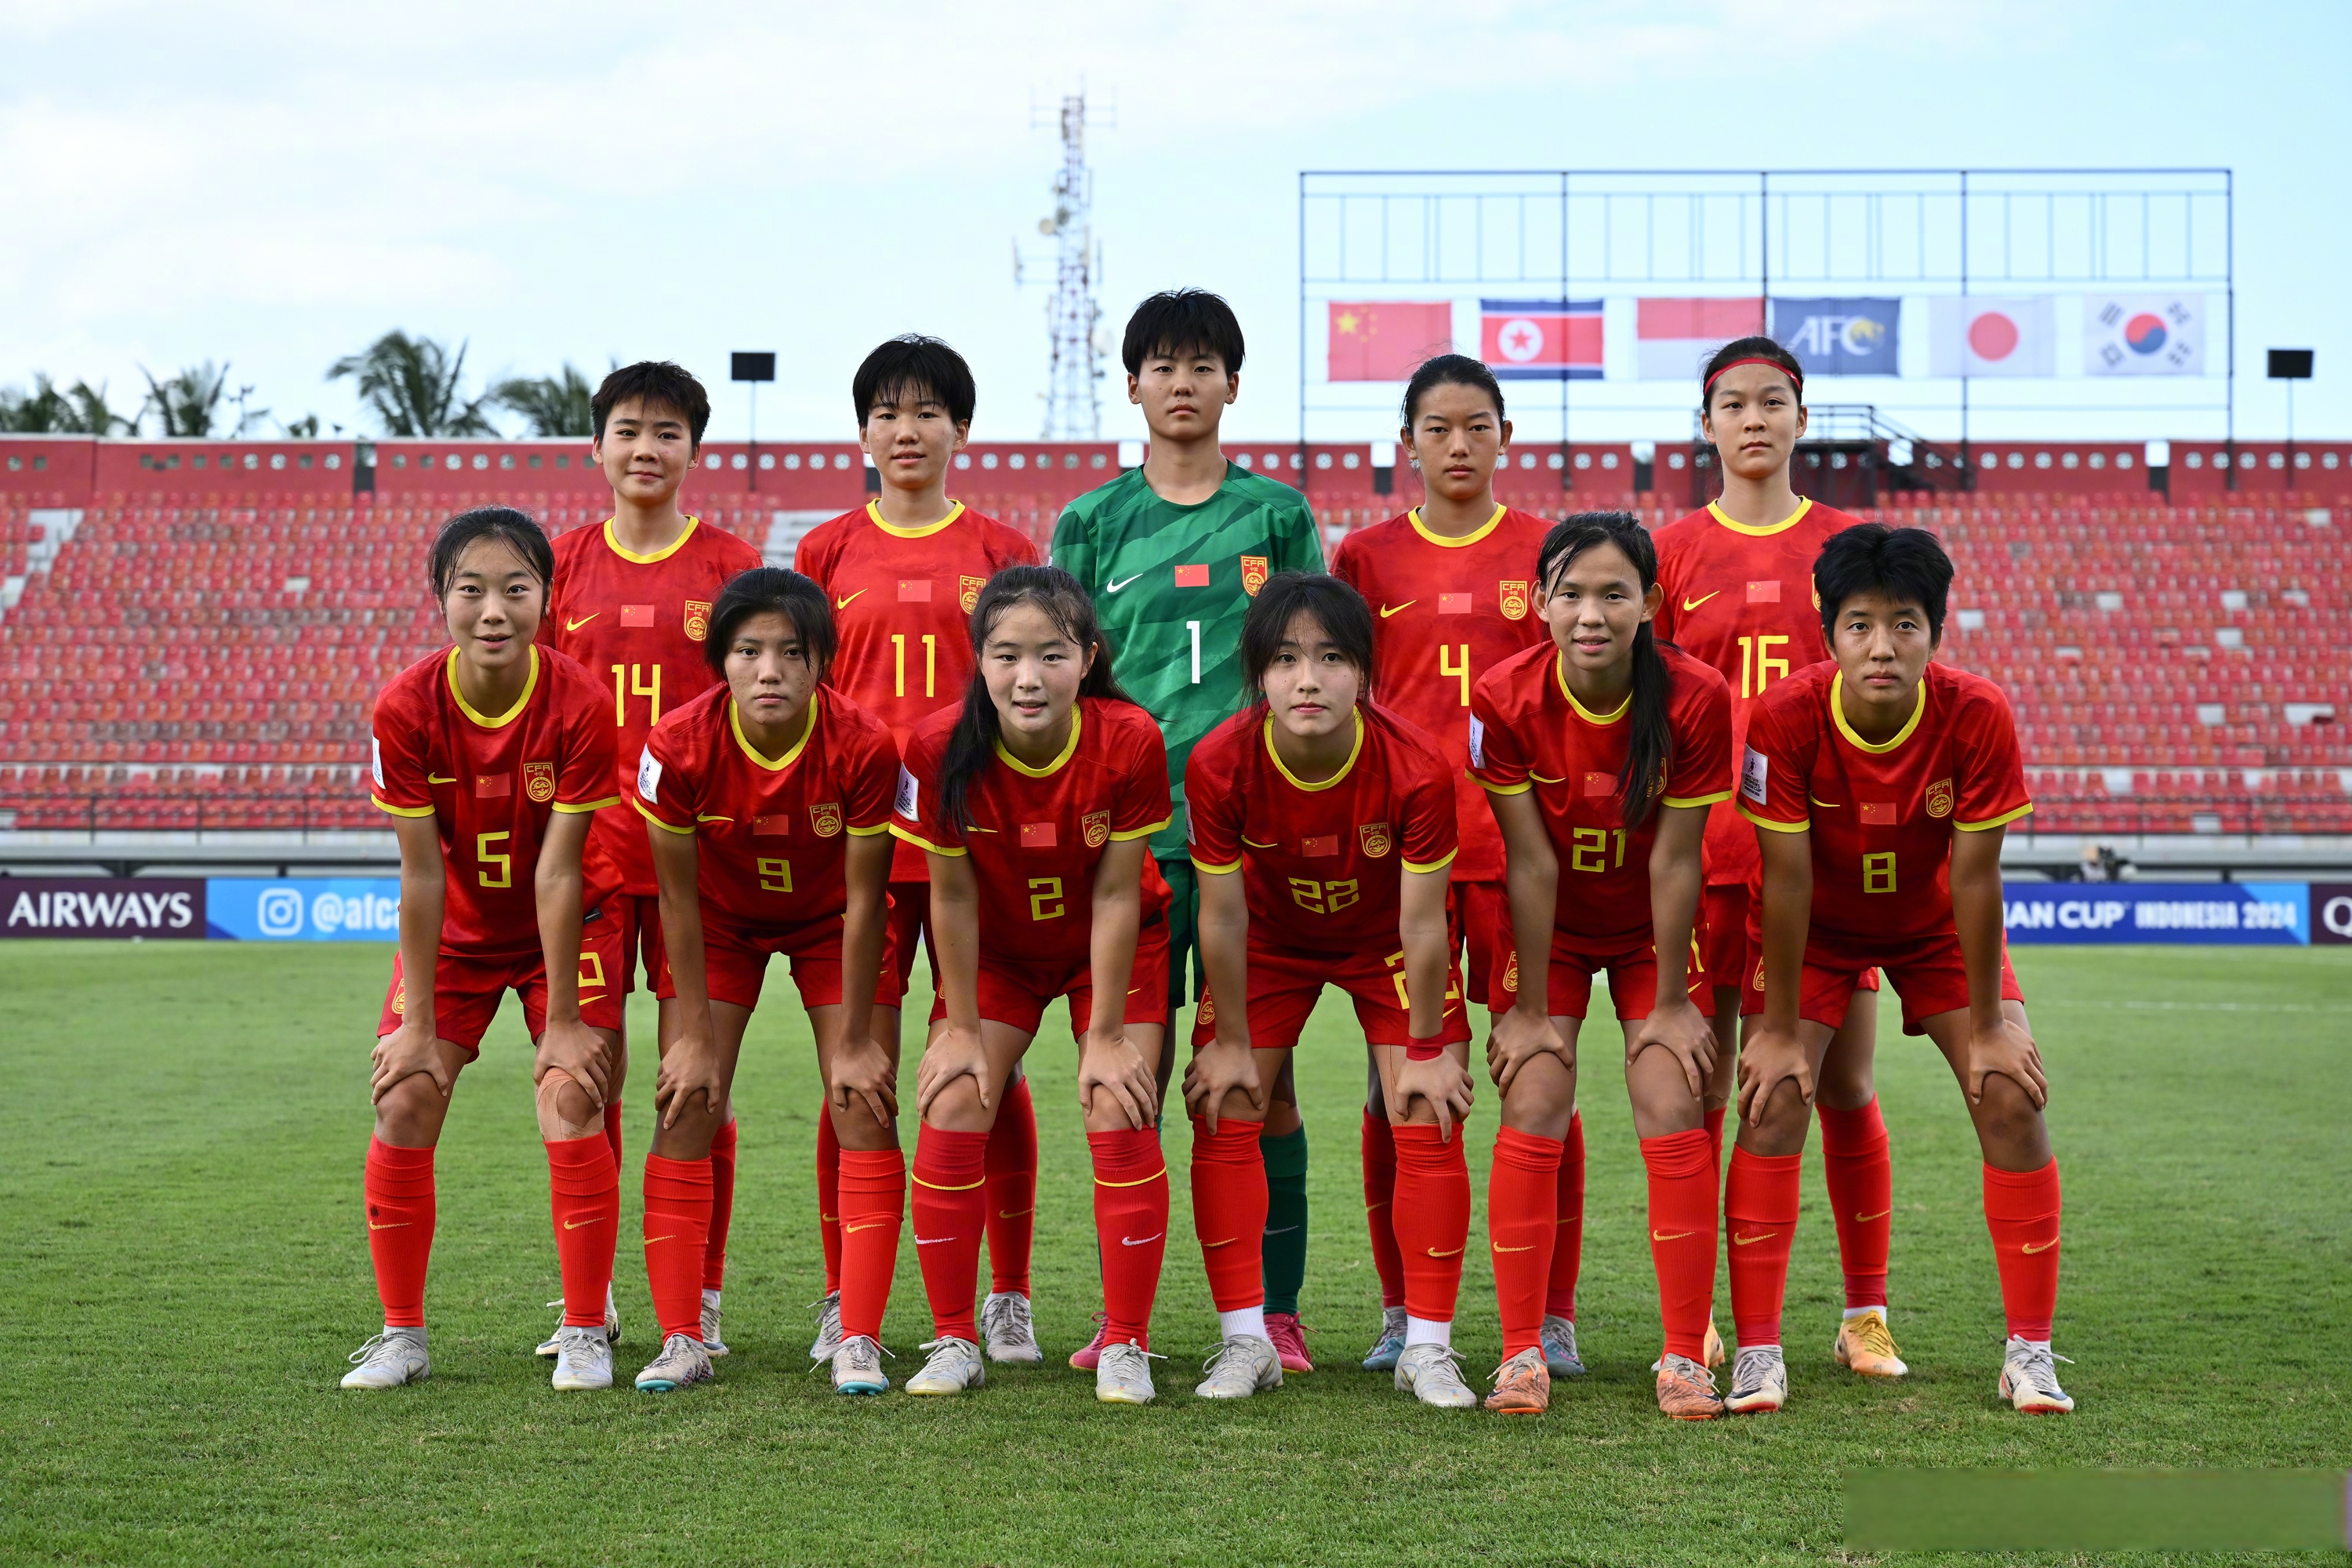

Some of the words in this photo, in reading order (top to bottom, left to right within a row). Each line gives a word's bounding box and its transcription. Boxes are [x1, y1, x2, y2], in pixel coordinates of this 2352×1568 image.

[1788, 315, 1879, 355] AFC
[1243, 559, 1265, 568] CFA
[962, 578, 984, 588] CFA
[688, 603, 710, 612] CFA
[891, 633, 935, 698] 11
[1186, 620, 1200, 684] 1
[1737, 635, 1789, 699] 16
[1439, 644, 1470, 706] 4
[611, 663, 661, 727] 14
[526, 764, 550, 773] CFA
[1928, 781, 1949, 795] CFA
[812, 804, 837, 814] CFA
[1084, 812, 1106, 825] CFA
[1362, 824, 1386, 834] CFA
[477, 830, 512, 888] 5
[1572, 827, 1626, 873] 21
[757, 857, 793, 893] 9
[1862, 851, 1896, 894] 8
[8, 891, 193, 928] AIRWAYS
[1028, 877, 1065, 921] 2
[1287, 877, 1360, 915] 22
[2057, 901, 2125, 929] CUP
[2135, 902, 2239, 929] INDONESIA
[2242, 902, 2297, 929] 2024
[2322, 896, 2352, 938] Q
